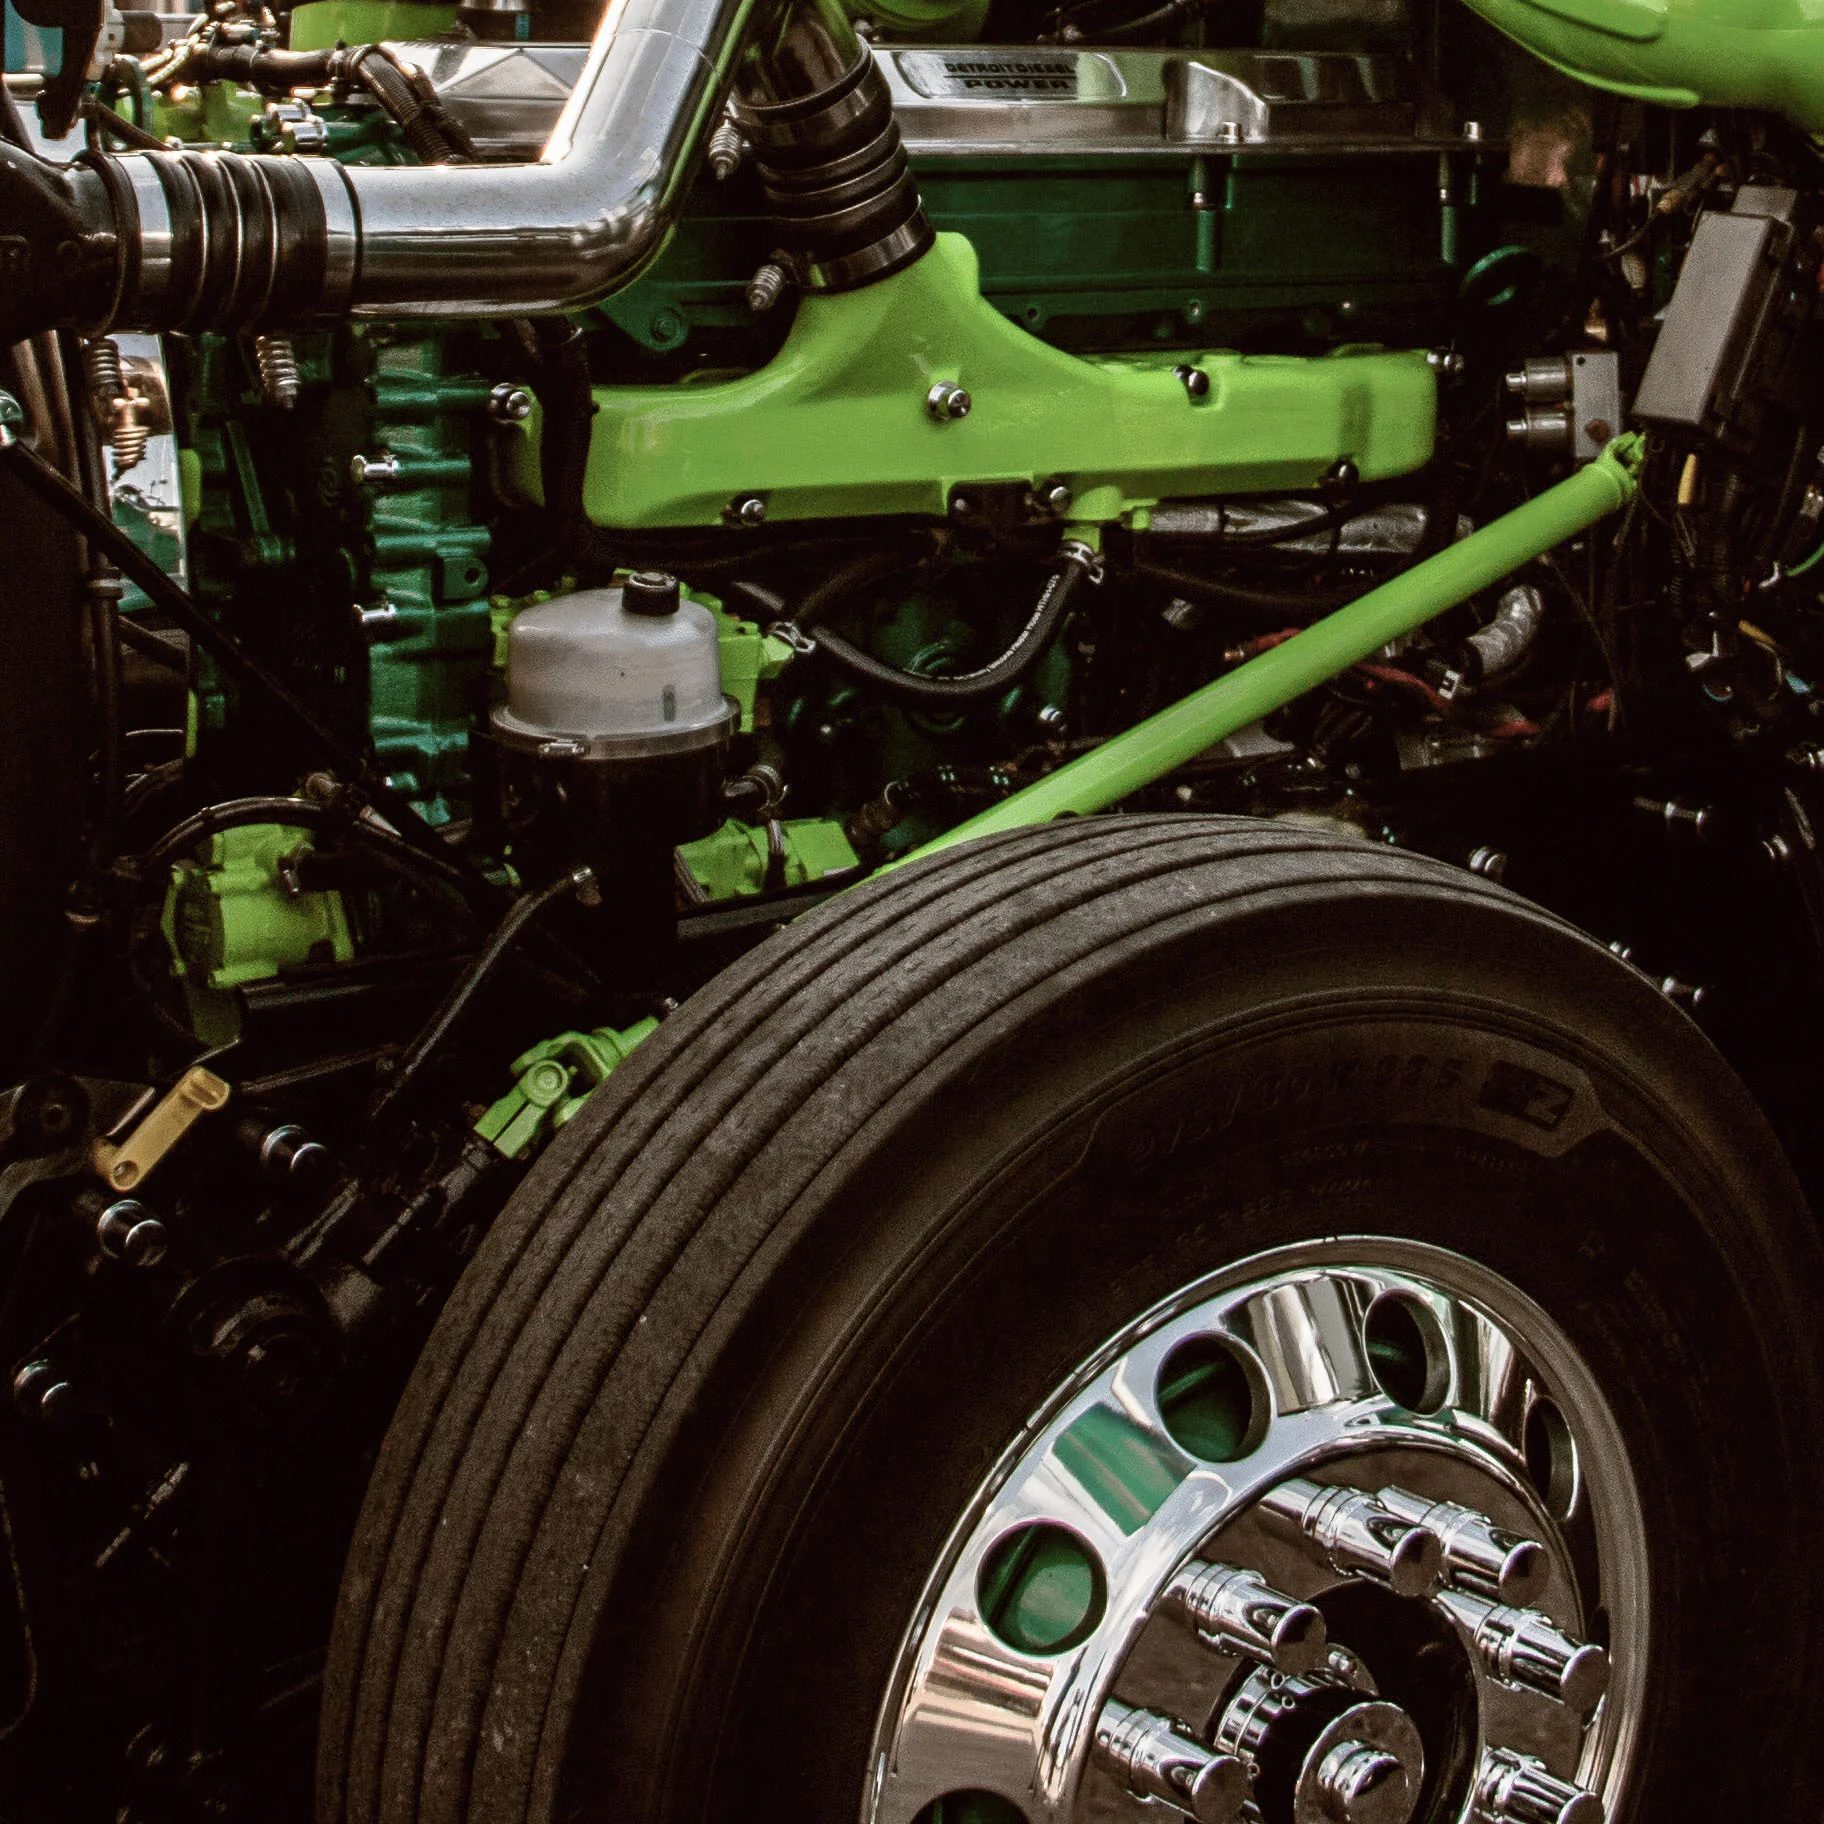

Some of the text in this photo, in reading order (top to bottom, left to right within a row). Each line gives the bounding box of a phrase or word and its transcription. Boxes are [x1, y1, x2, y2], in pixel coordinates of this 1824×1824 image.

[944, 62, 1077, 74] DETROIT DIESEL
[964, 79, 1071, 90] POWER
